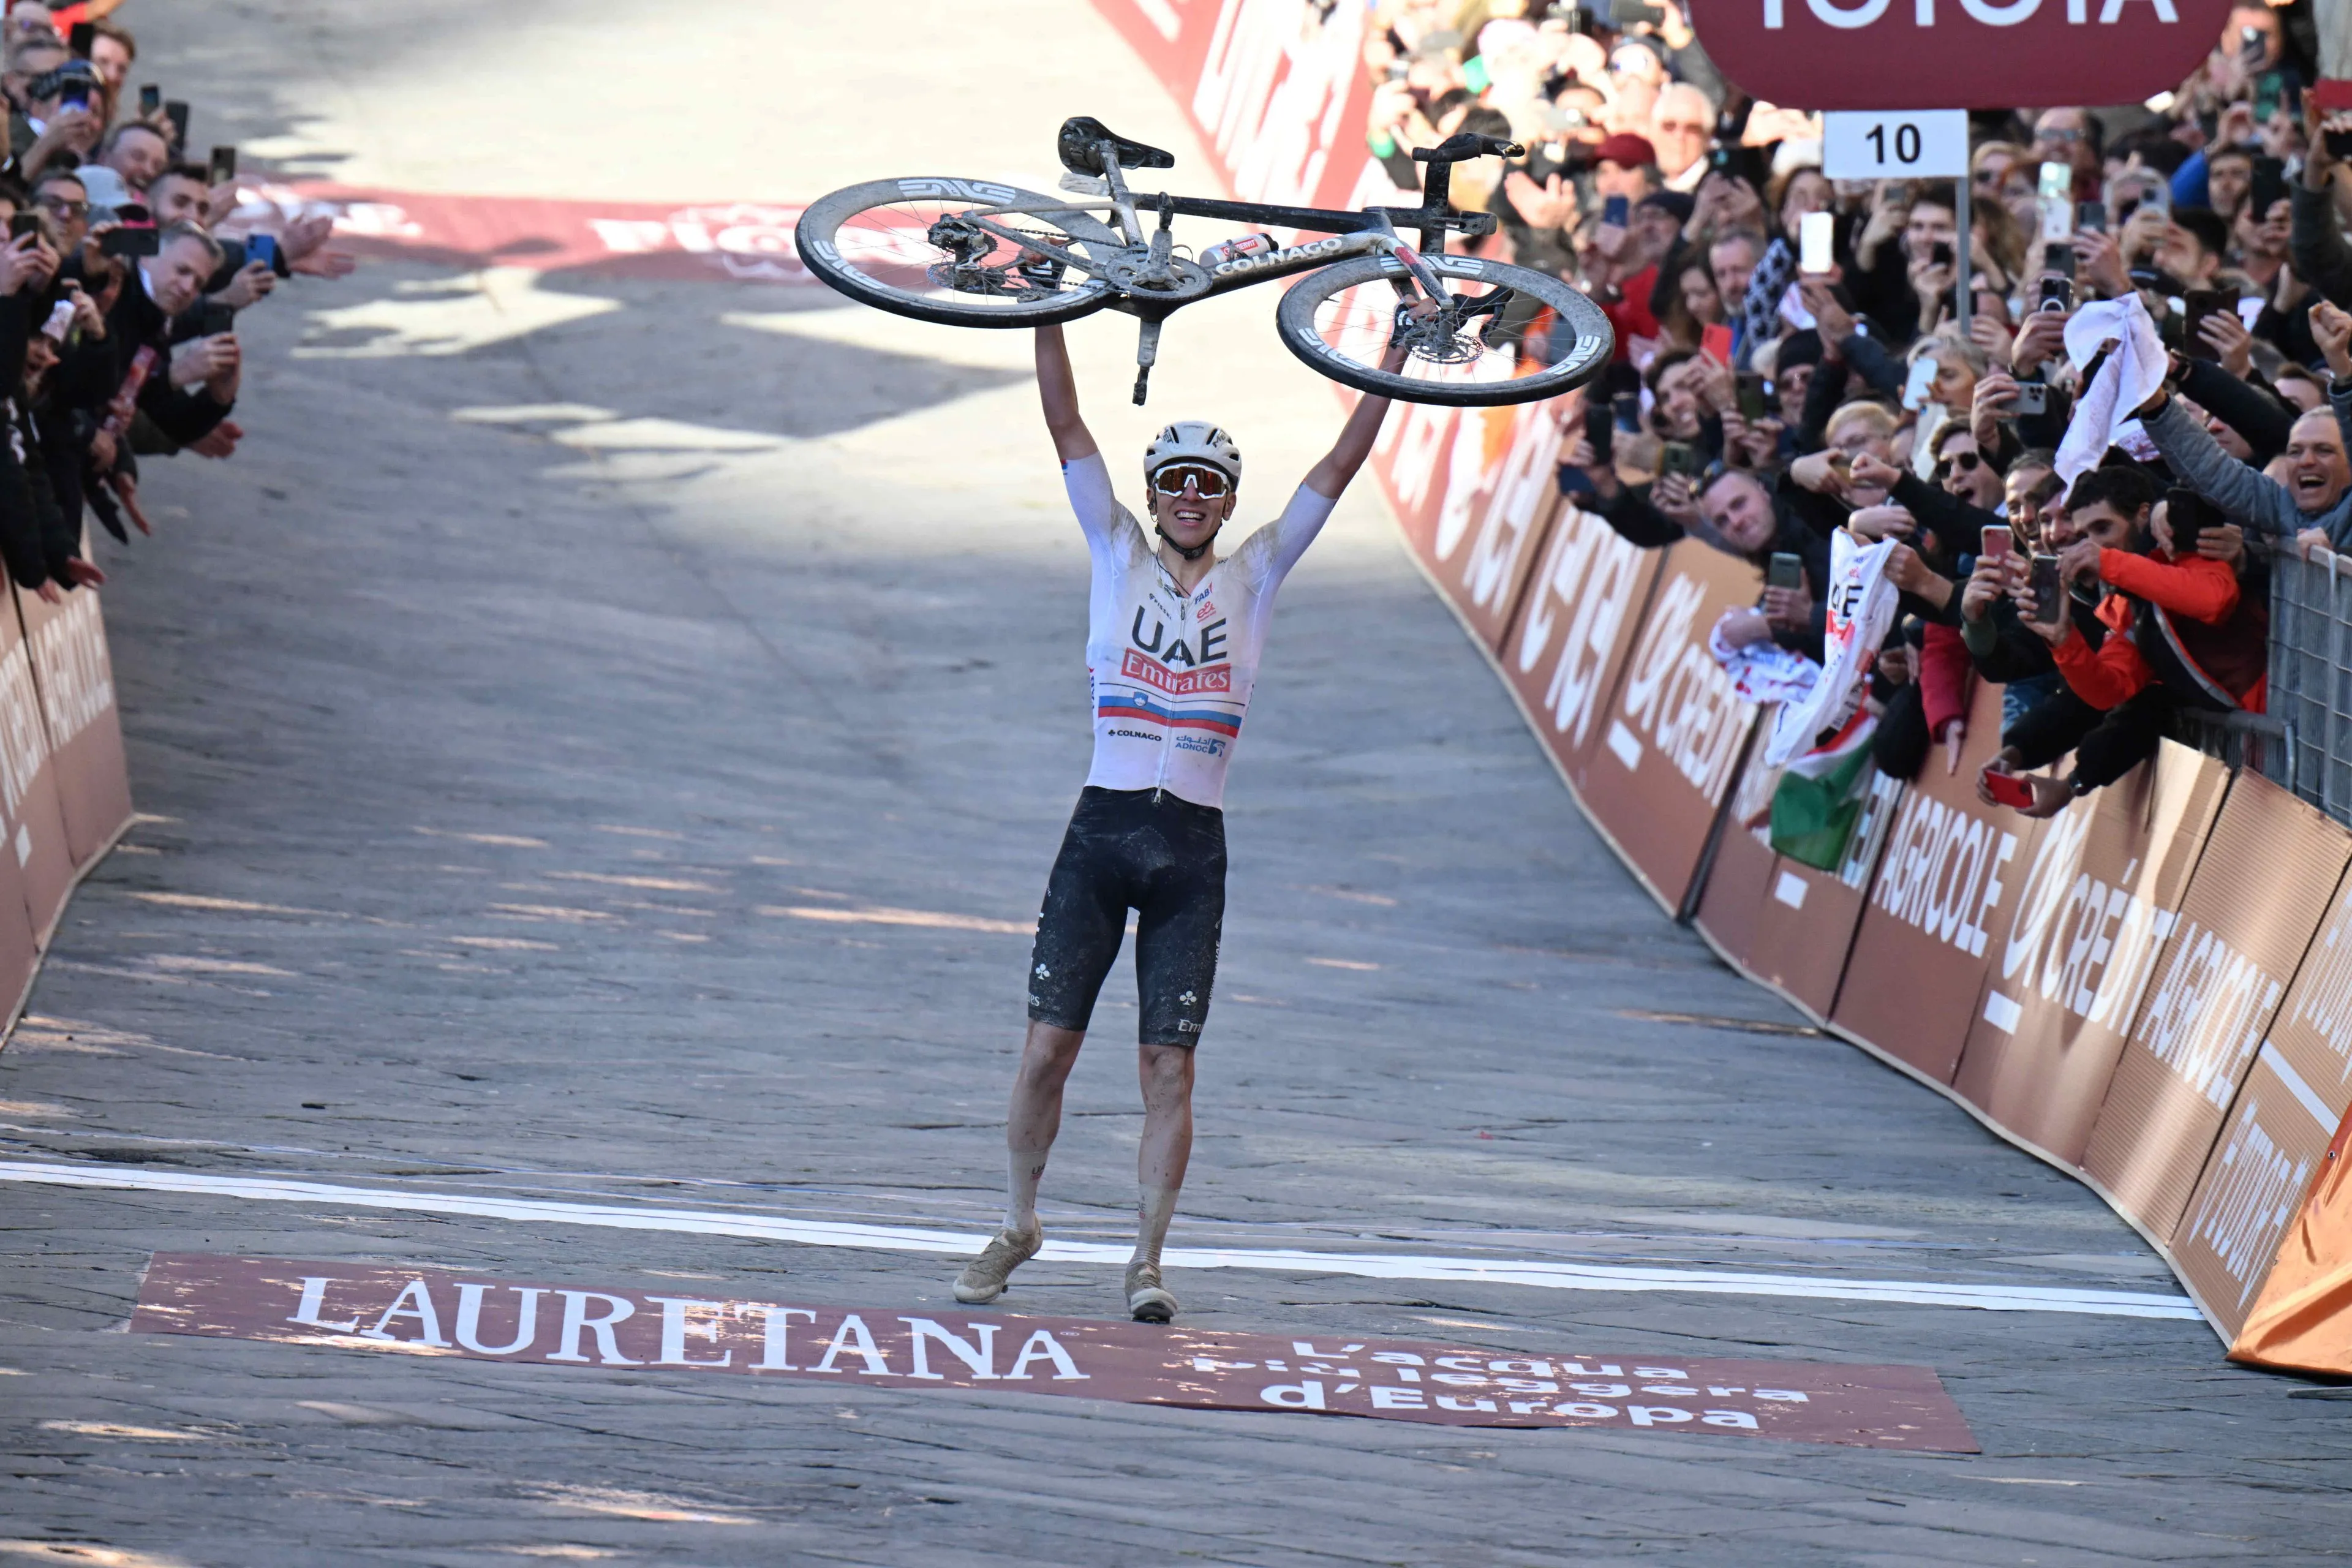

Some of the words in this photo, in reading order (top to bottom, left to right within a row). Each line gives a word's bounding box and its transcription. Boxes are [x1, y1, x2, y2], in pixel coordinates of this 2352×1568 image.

[1866, 123, 1921, 164] 10
[1216, 238, 1343, 275] COLNAGO
[1132, 605, 1227, 667] UAE
[1126, 654, 1228, 692] Emirates
[1117, 730, 1162, 742] COLNAGO
[1175, 742, 1209, 753] ADNOC
[1872, 791, 2018, 959] AGRICOLE
[2041, 858, 2182, 1037] CRÉDIT
[2137, 922, 2280, 1111] AGRICOLE
[285, 1276, 1090, 1380] LAURETANA
[1292, 1341, 1689, 1379] L'acqua
[1260, 1379, 1760, 1430] d'Europa
[1396, 1367, 1810, 1403] leggera
